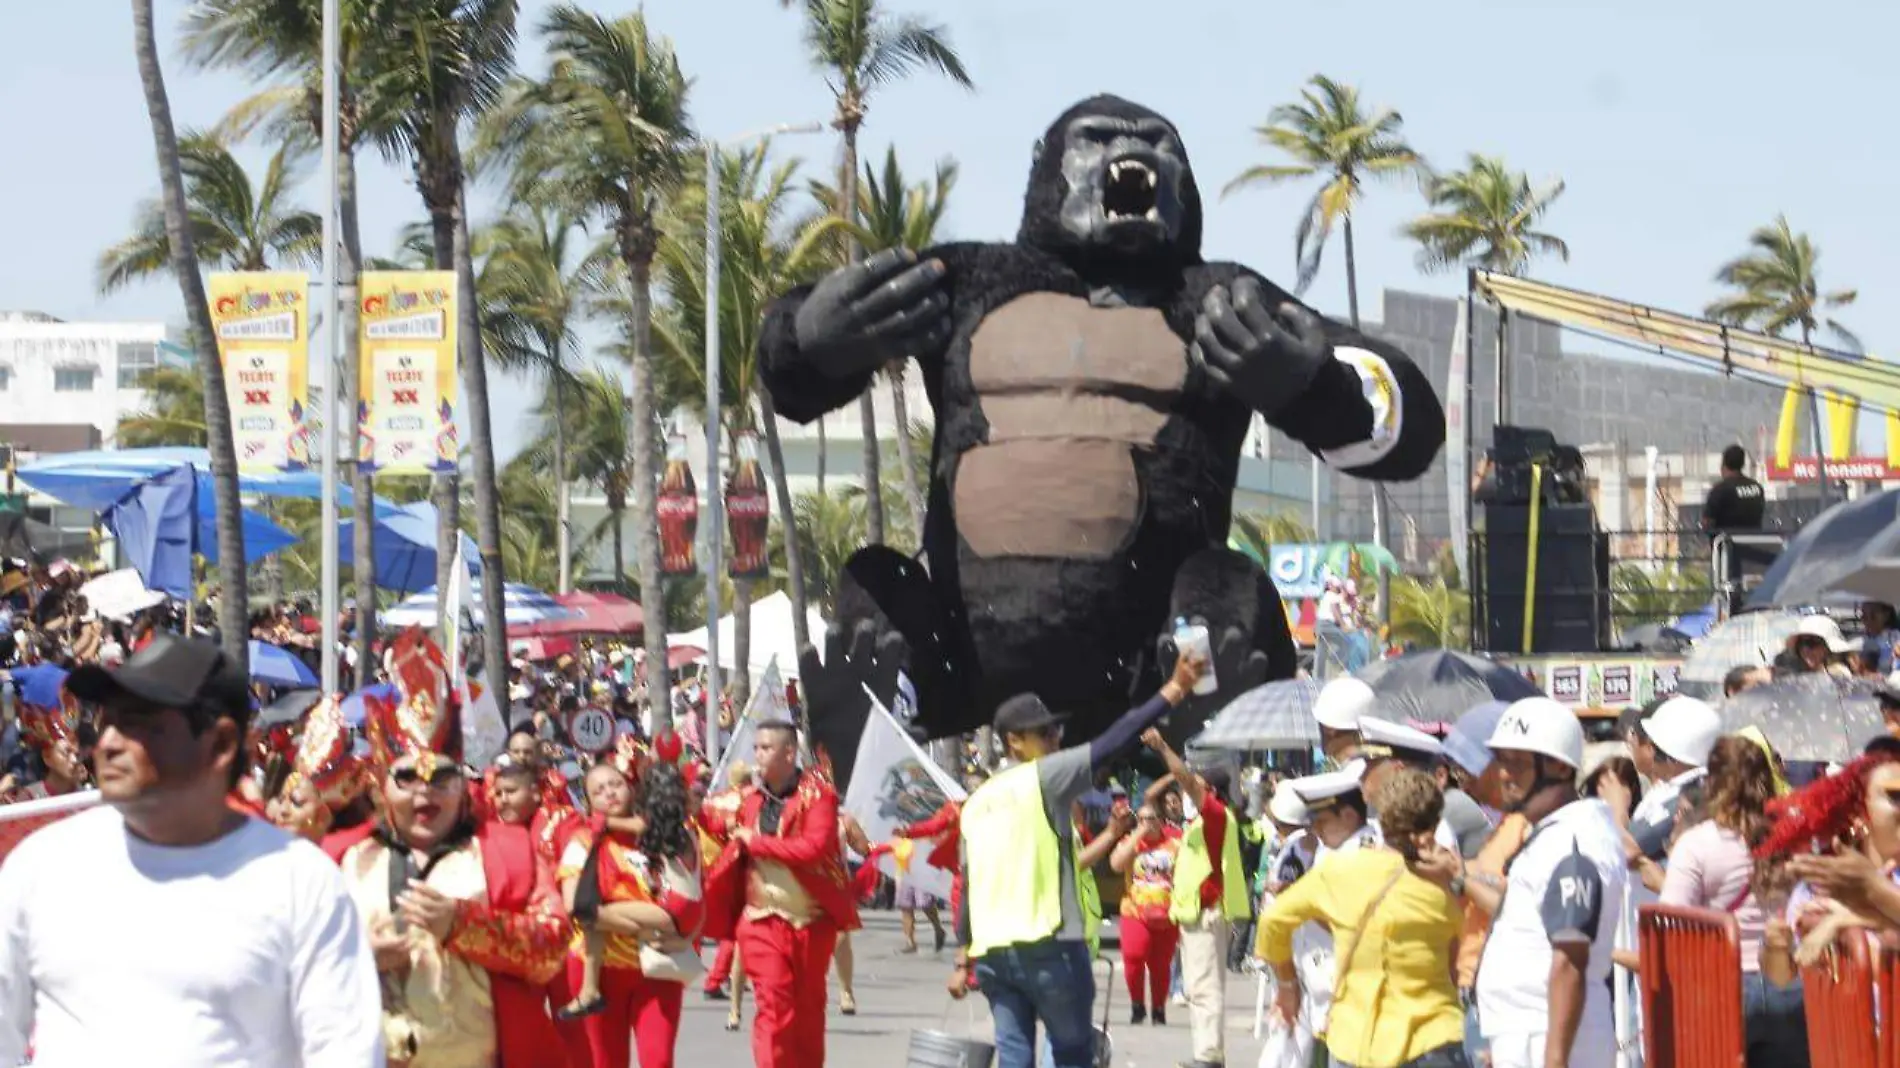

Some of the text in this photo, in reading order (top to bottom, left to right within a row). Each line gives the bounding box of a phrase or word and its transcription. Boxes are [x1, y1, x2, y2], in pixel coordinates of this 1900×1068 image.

[243, 390, 271, 405] XX
[391, 389, 420, 405] XX
[579, 714, 605, 736] 40
[1559, 876, 1593, 910] PN
